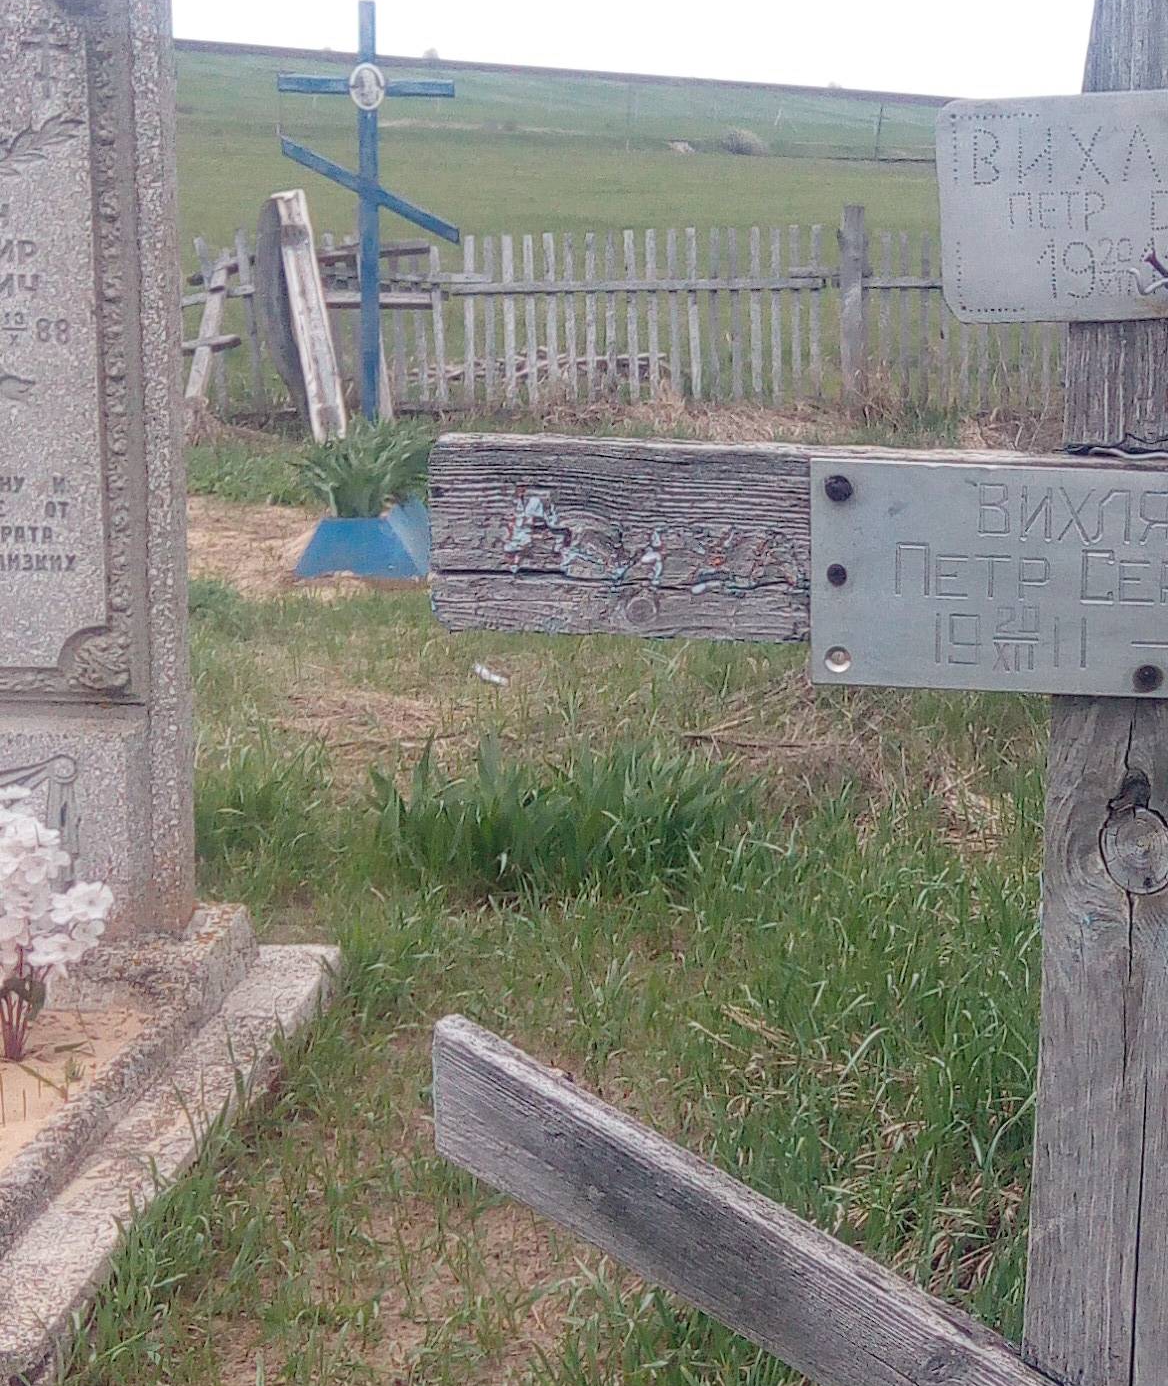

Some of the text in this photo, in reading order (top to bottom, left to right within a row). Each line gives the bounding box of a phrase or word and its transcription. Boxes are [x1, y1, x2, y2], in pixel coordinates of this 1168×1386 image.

[1008, 190, 1106, 231] ПЕТР
[36, 317, 71, 345] 88
[44, 500, 70, 519] ОТ
[895, 541, 1053, 602] ПЕТР
